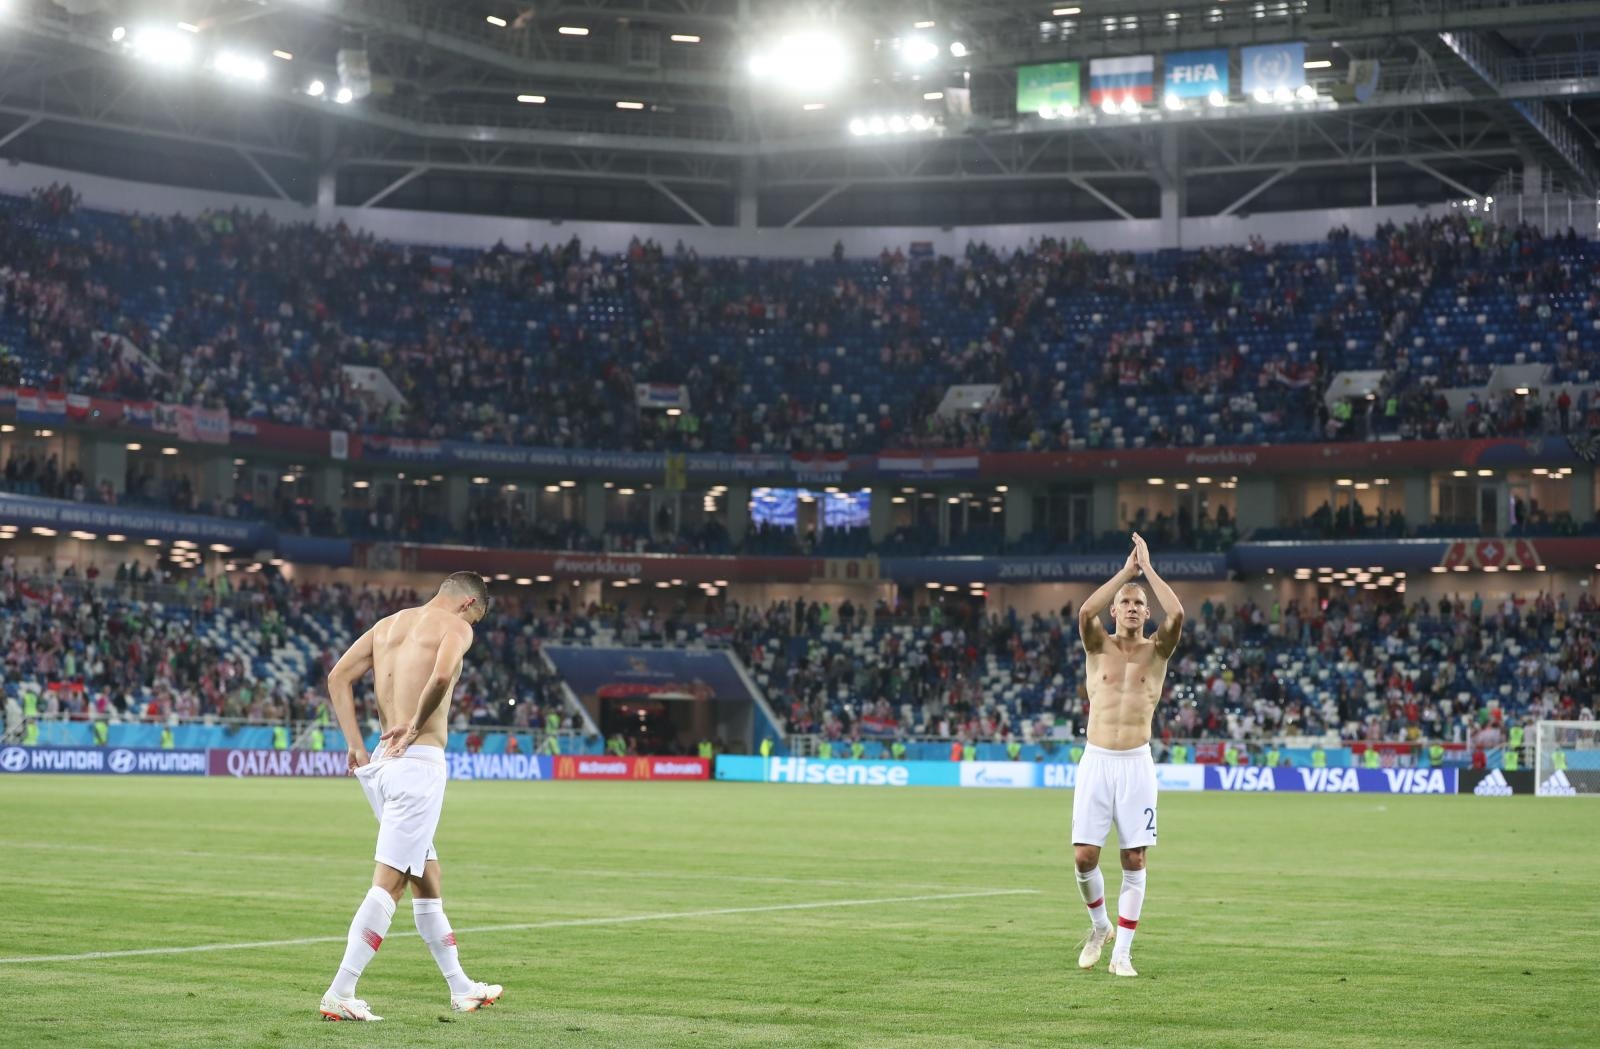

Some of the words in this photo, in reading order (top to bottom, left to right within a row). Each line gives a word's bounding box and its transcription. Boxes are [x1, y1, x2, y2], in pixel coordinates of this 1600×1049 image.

[1172, 63, 1219, 83] FIFA
[1161, 560, 1215, 575] RUSSIA
[32, 750, 104, 769] HYUNDAI
[138, 752, 205, 771] HYUNDAI
[227, 750, 292, 777] QATAR
[295, 751, 348, 776] AIRW
[472, 754, 541, 779] WANDA
[770, 757, 909, 785] Hisense
[1044, 763, 1076, 787] GAZ
[1214, 766, 1276, 790] VISA
[1297, 767, 1360, 792] VISA
[1382, 768, 1445, 793] VISA
[1474, 785, 1513, 797] adidas
[1143, 807, 1157, 831] 2
